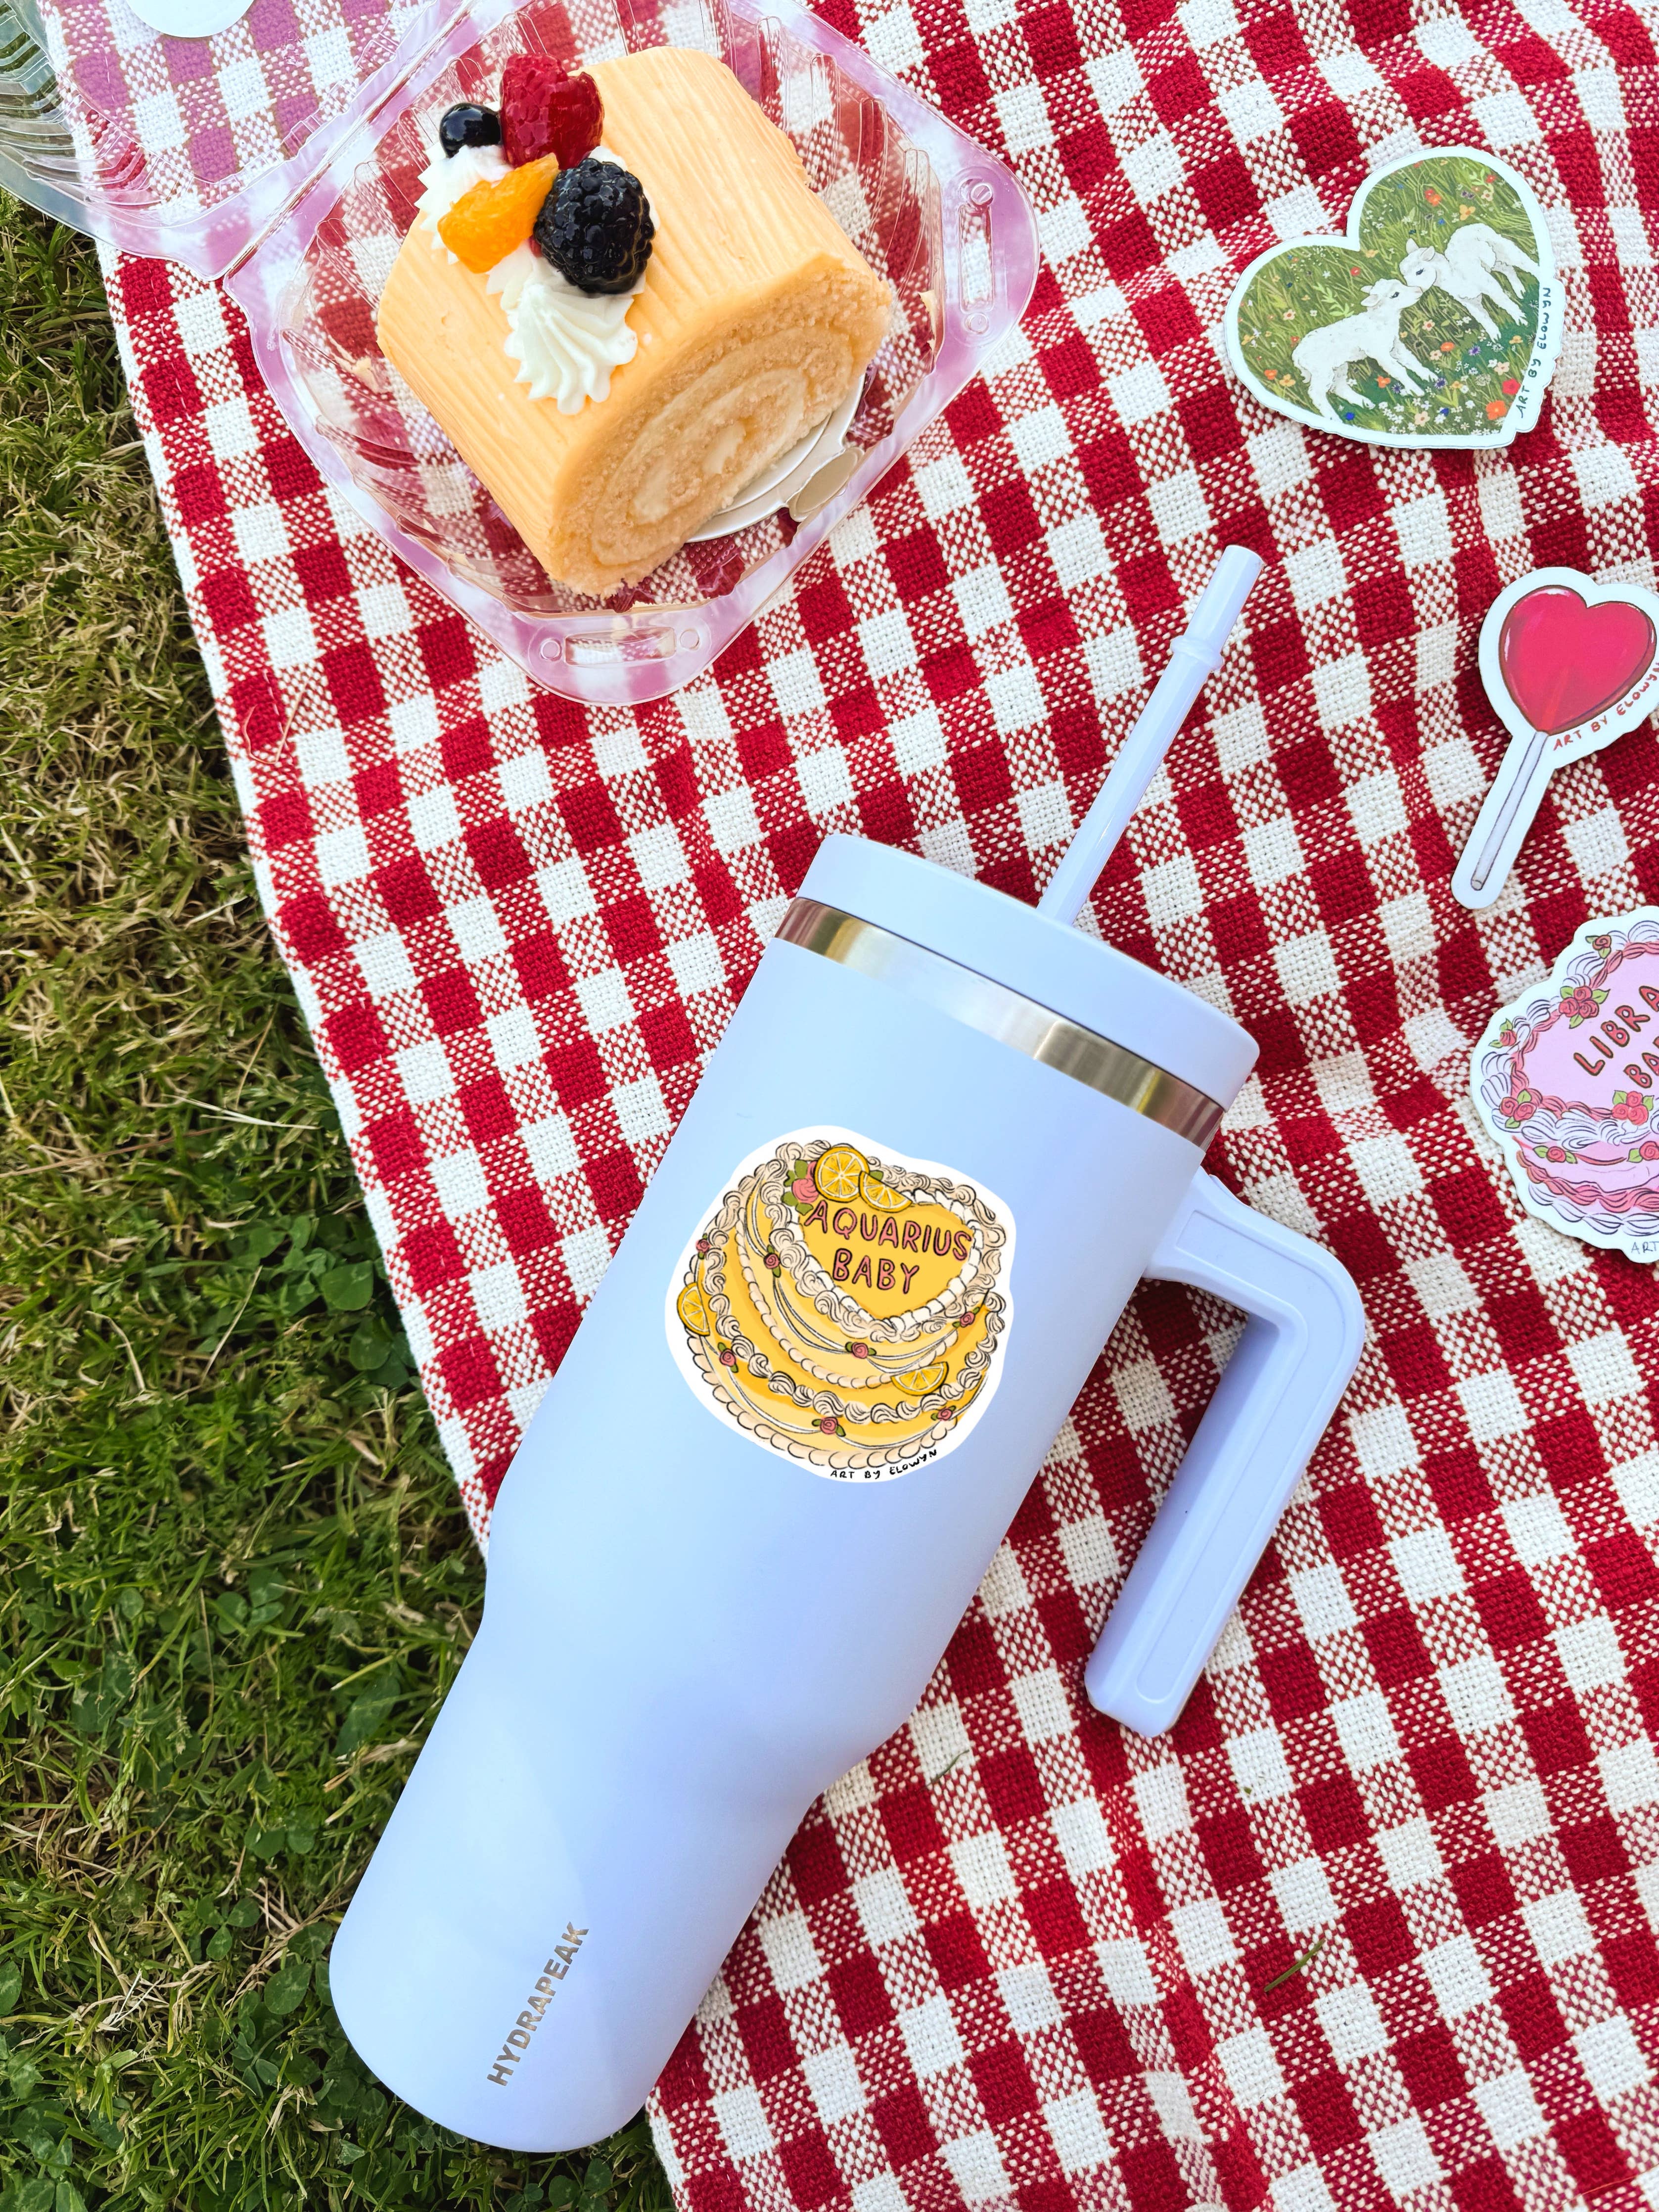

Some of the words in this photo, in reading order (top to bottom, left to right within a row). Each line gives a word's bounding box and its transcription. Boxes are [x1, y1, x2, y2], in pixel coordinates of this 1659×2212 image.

[1516, 385, 1530, 418] ART
[1528, 359, 1541, 377] BY
[1537, 287, 1552, 349] ELOWYN
[1553, 730, 1582, 751] ART
[1590, 715, 1607, 733] BY
[803, 1199, 972, 1261] AQUARIUS
[1631, 1241, 1659, 1254] ART
[832, 1247, 920, 1294] BABY
[830, 1470, 855, 1479] ART
[864, 1470, 880, 1479] BY
[889, 1449, 937, 1475] ELOWYN
[487, 1921, 590, 2086] HYDRAPEAK
